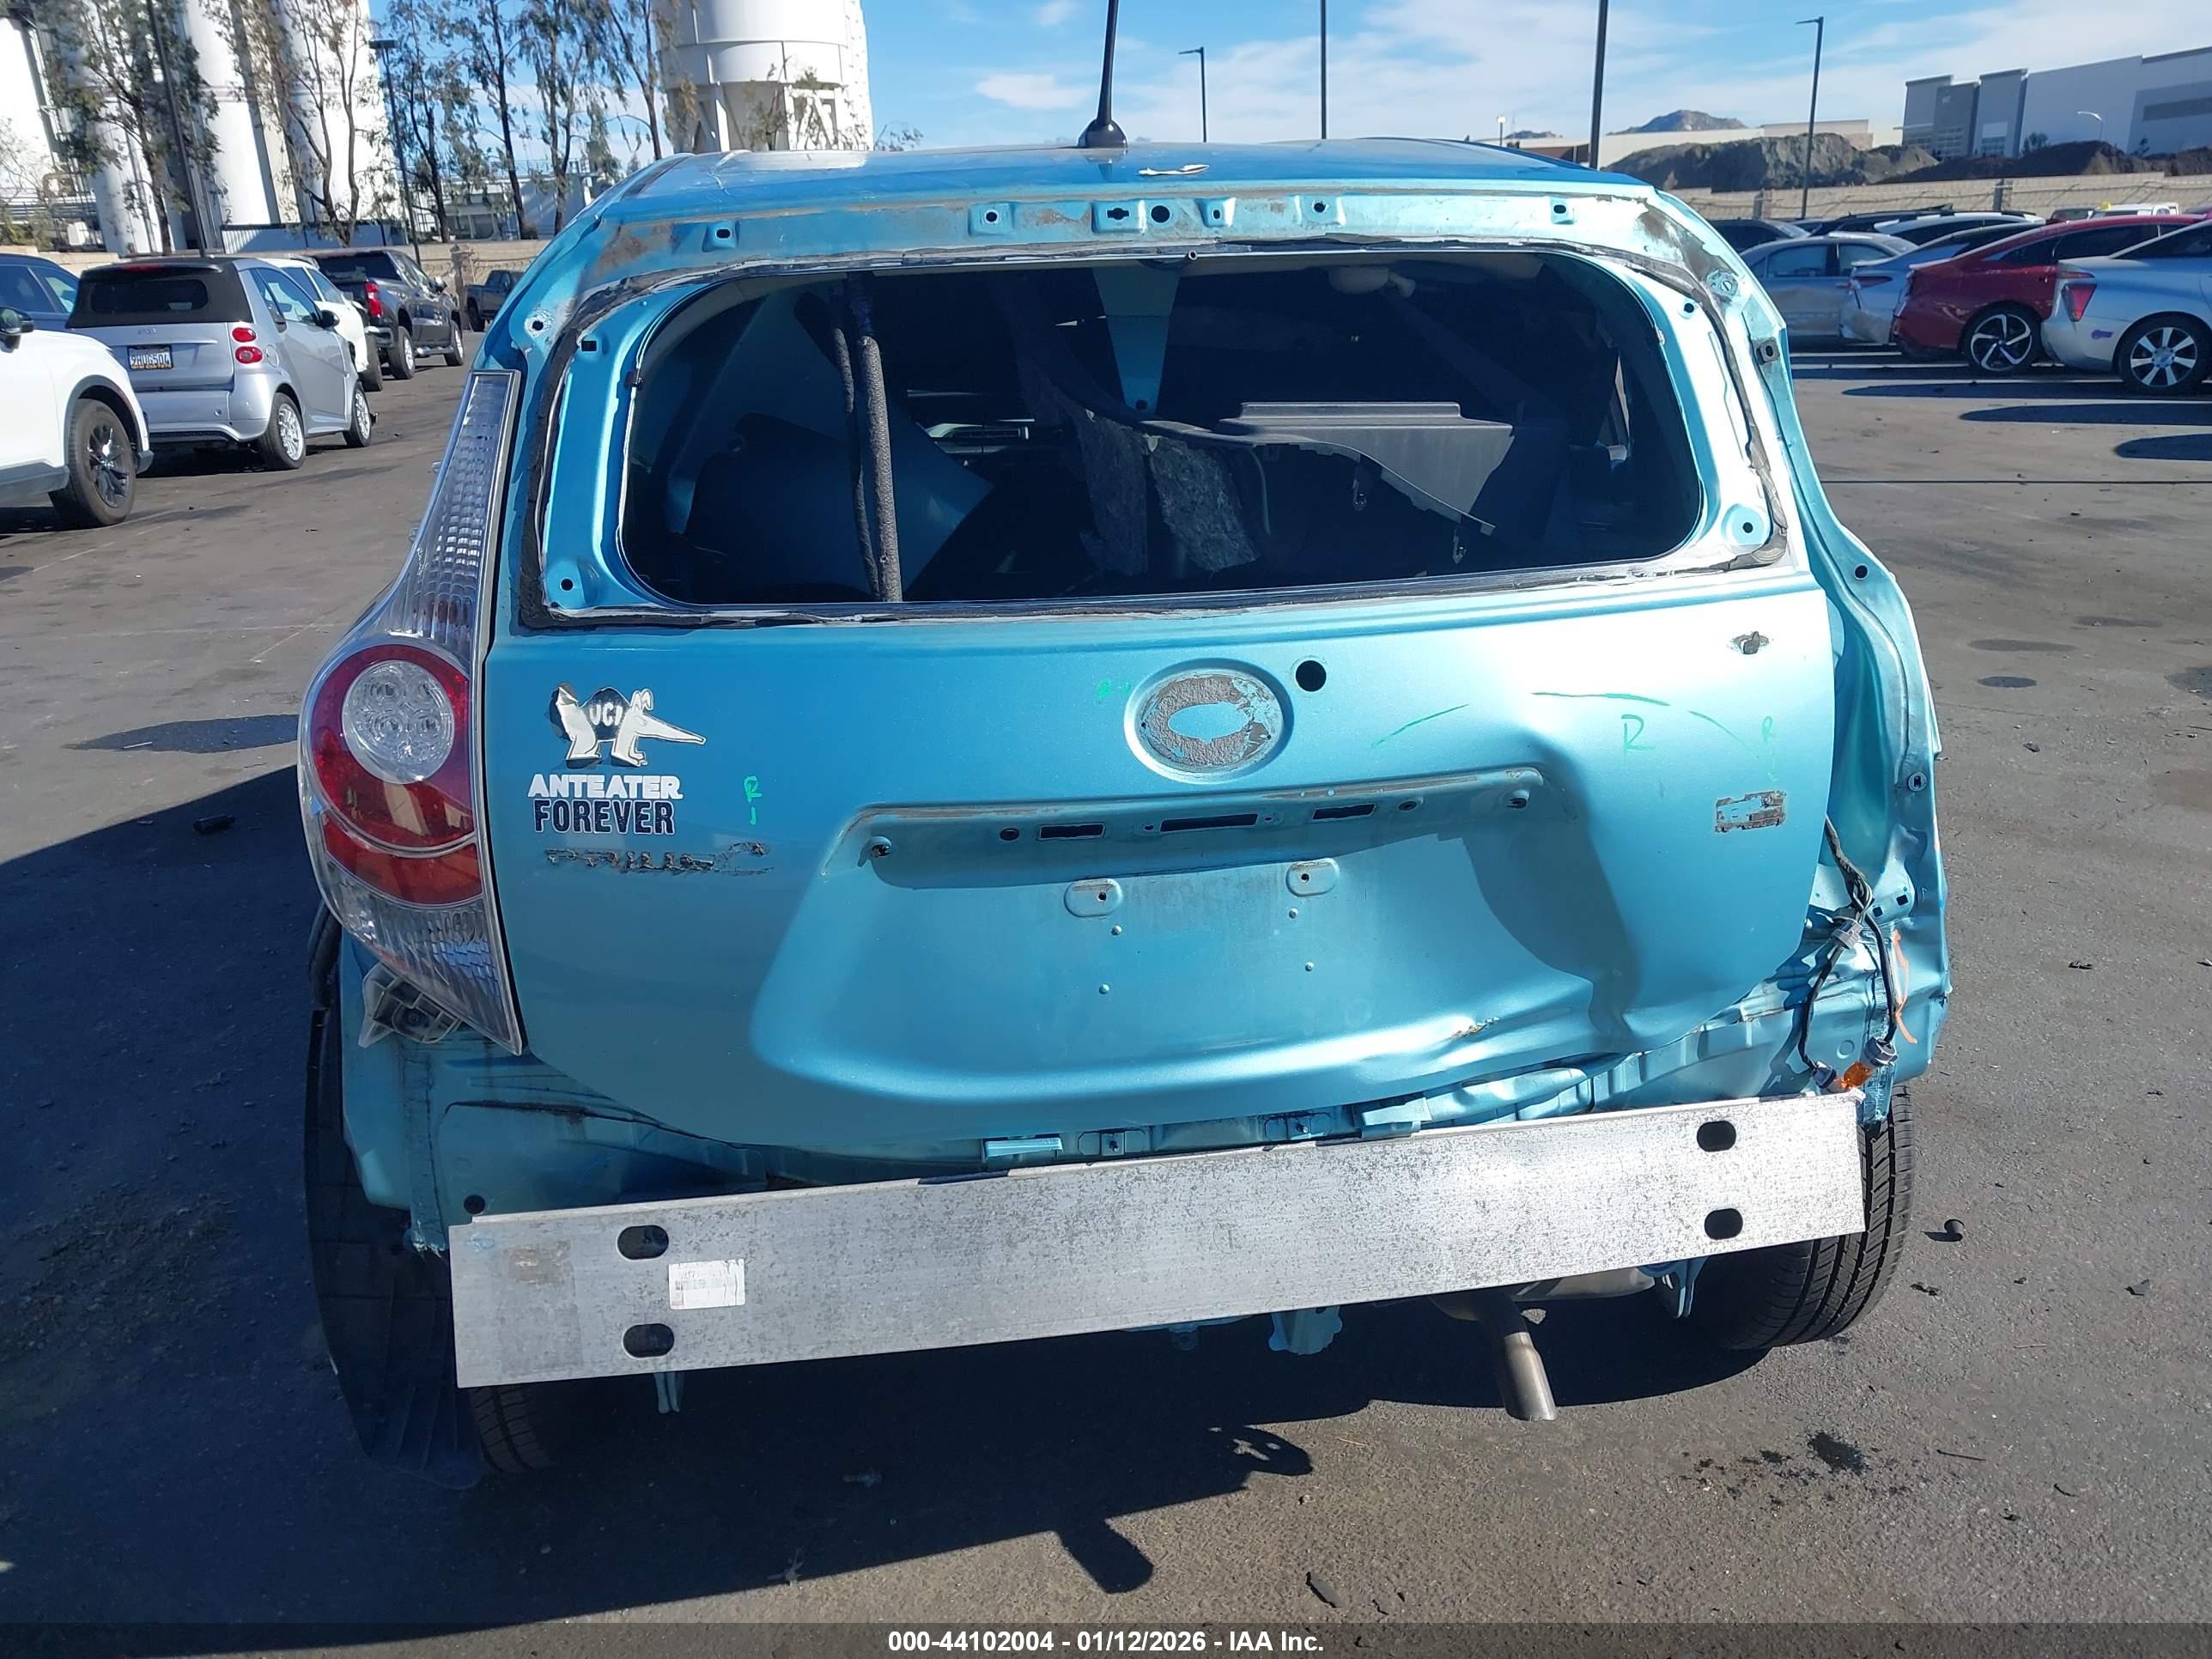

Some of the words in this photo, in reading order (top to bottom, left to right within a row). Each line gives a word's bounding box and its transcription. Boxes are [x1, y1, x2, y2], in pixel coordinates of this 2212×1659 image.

[589, 702, 623, 726] UCI
[527, 774, 683, 799] ANTEATER
[533, 799, 674, 834] FOREVER
